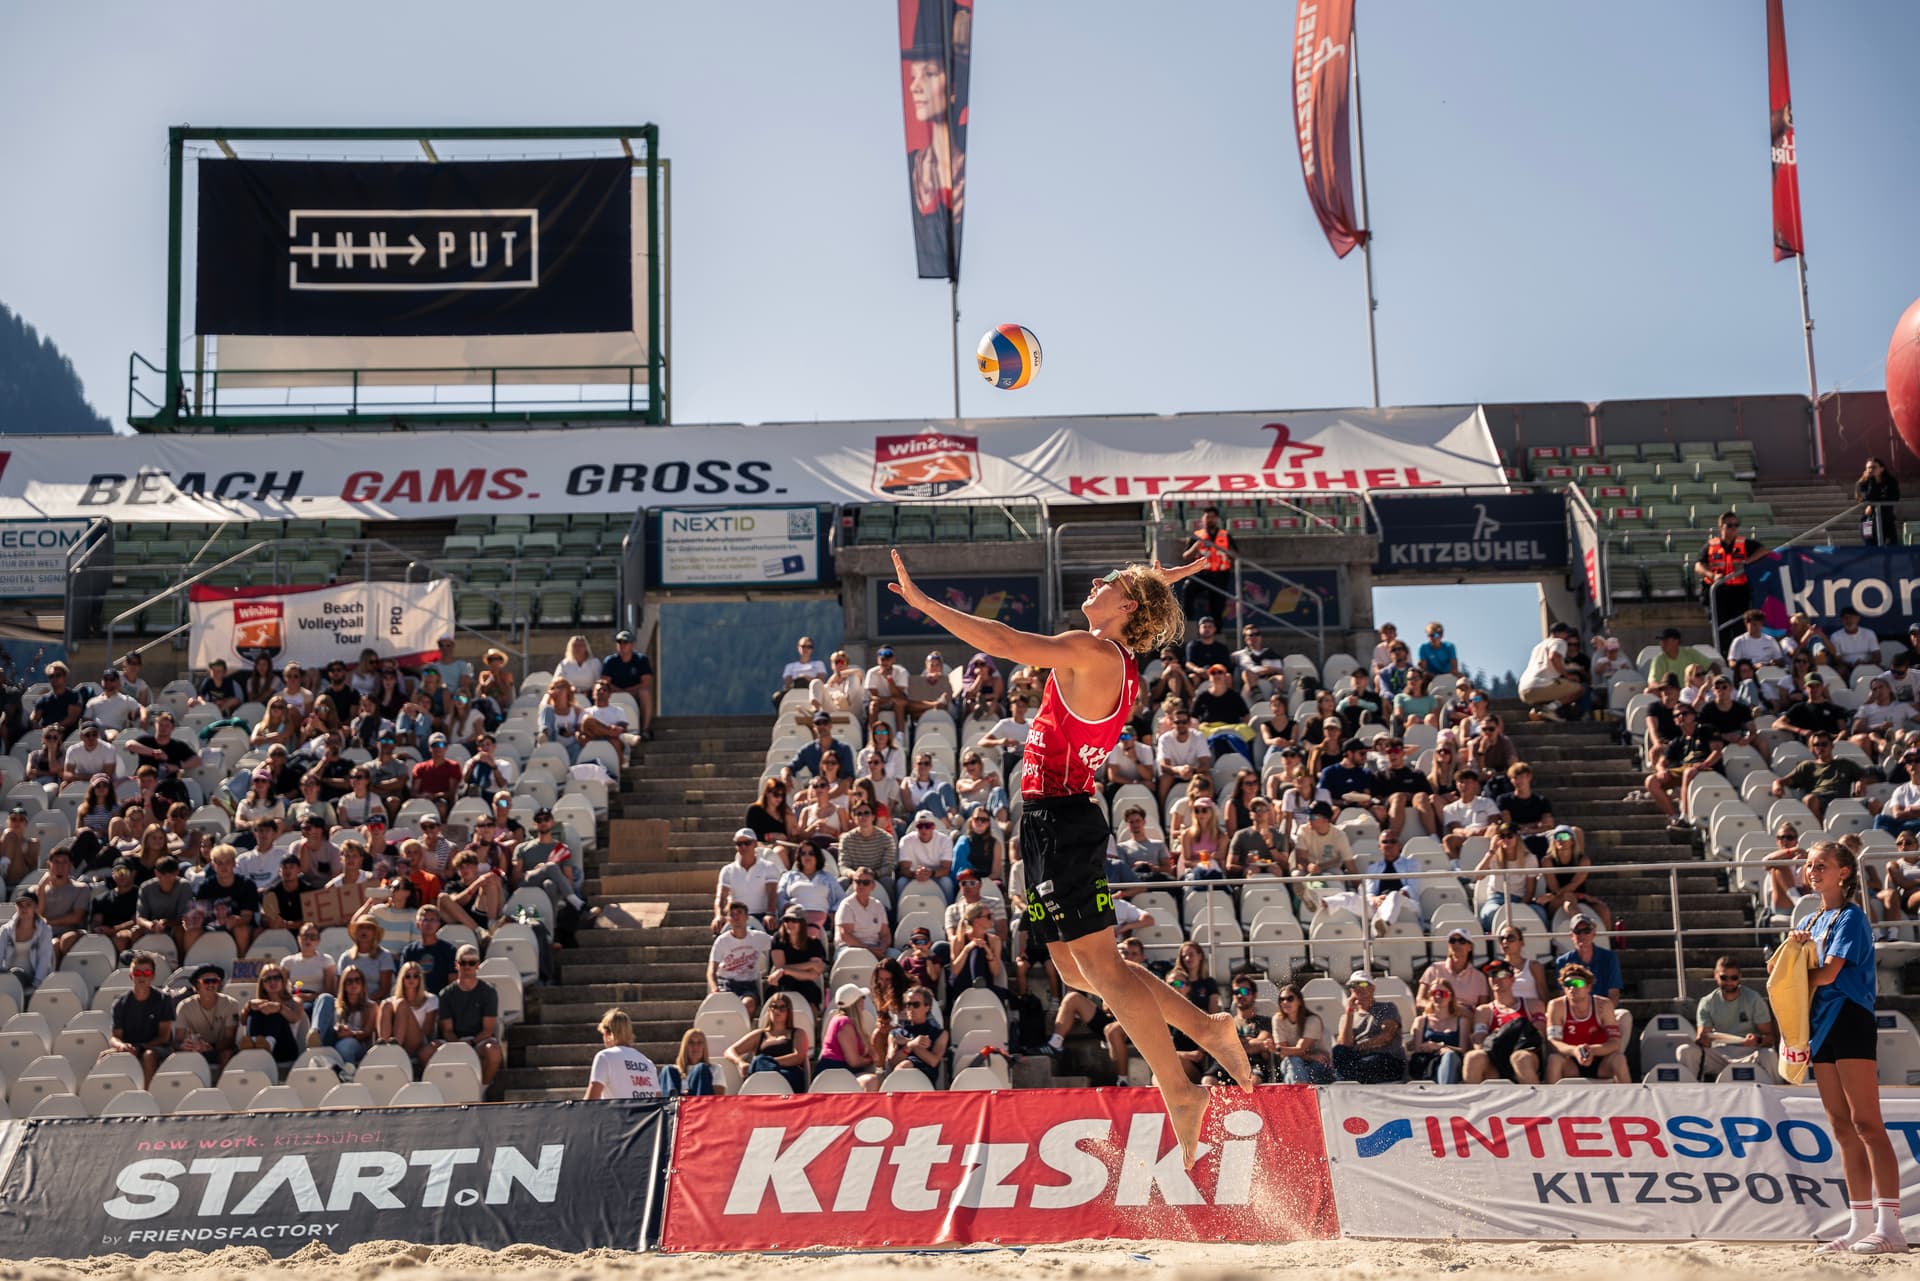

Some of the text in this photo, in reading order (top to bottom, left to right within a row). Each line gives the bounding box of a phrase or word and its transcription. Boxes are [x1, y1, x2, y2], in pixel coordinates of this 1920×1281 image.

[439, 231, 517, 268] PUT
[342, 468, 541, 503] GAMS.
[565, 459, 788, 496] GROSS.
[1069, 467, 1441, 497] KITZBÜHEL
[672, 516, 755, 532] NEXTID
[1390, 540, 1546, 565] KITZBÜHEL
[323, 601, 364, 614] Beach
[298, 617, 364, 632] Volleyball
[390, 606, 403, 636] PRO
[332, 631, 362, 645] Tour
[1568, 1025, 1577, 1035] 2
[138, 1140, 188, 1151] new
[199, 1135, 264, 1150] work.
[1425, 1116, 1920, 1164] INTERSPOT
[722, 1110, 1263, 1216] KitzSki
[1532, 1171, 1851, 1210] KITZSPORT
[102, 1223, 340, 1246] by FRIENDSFACTORY
